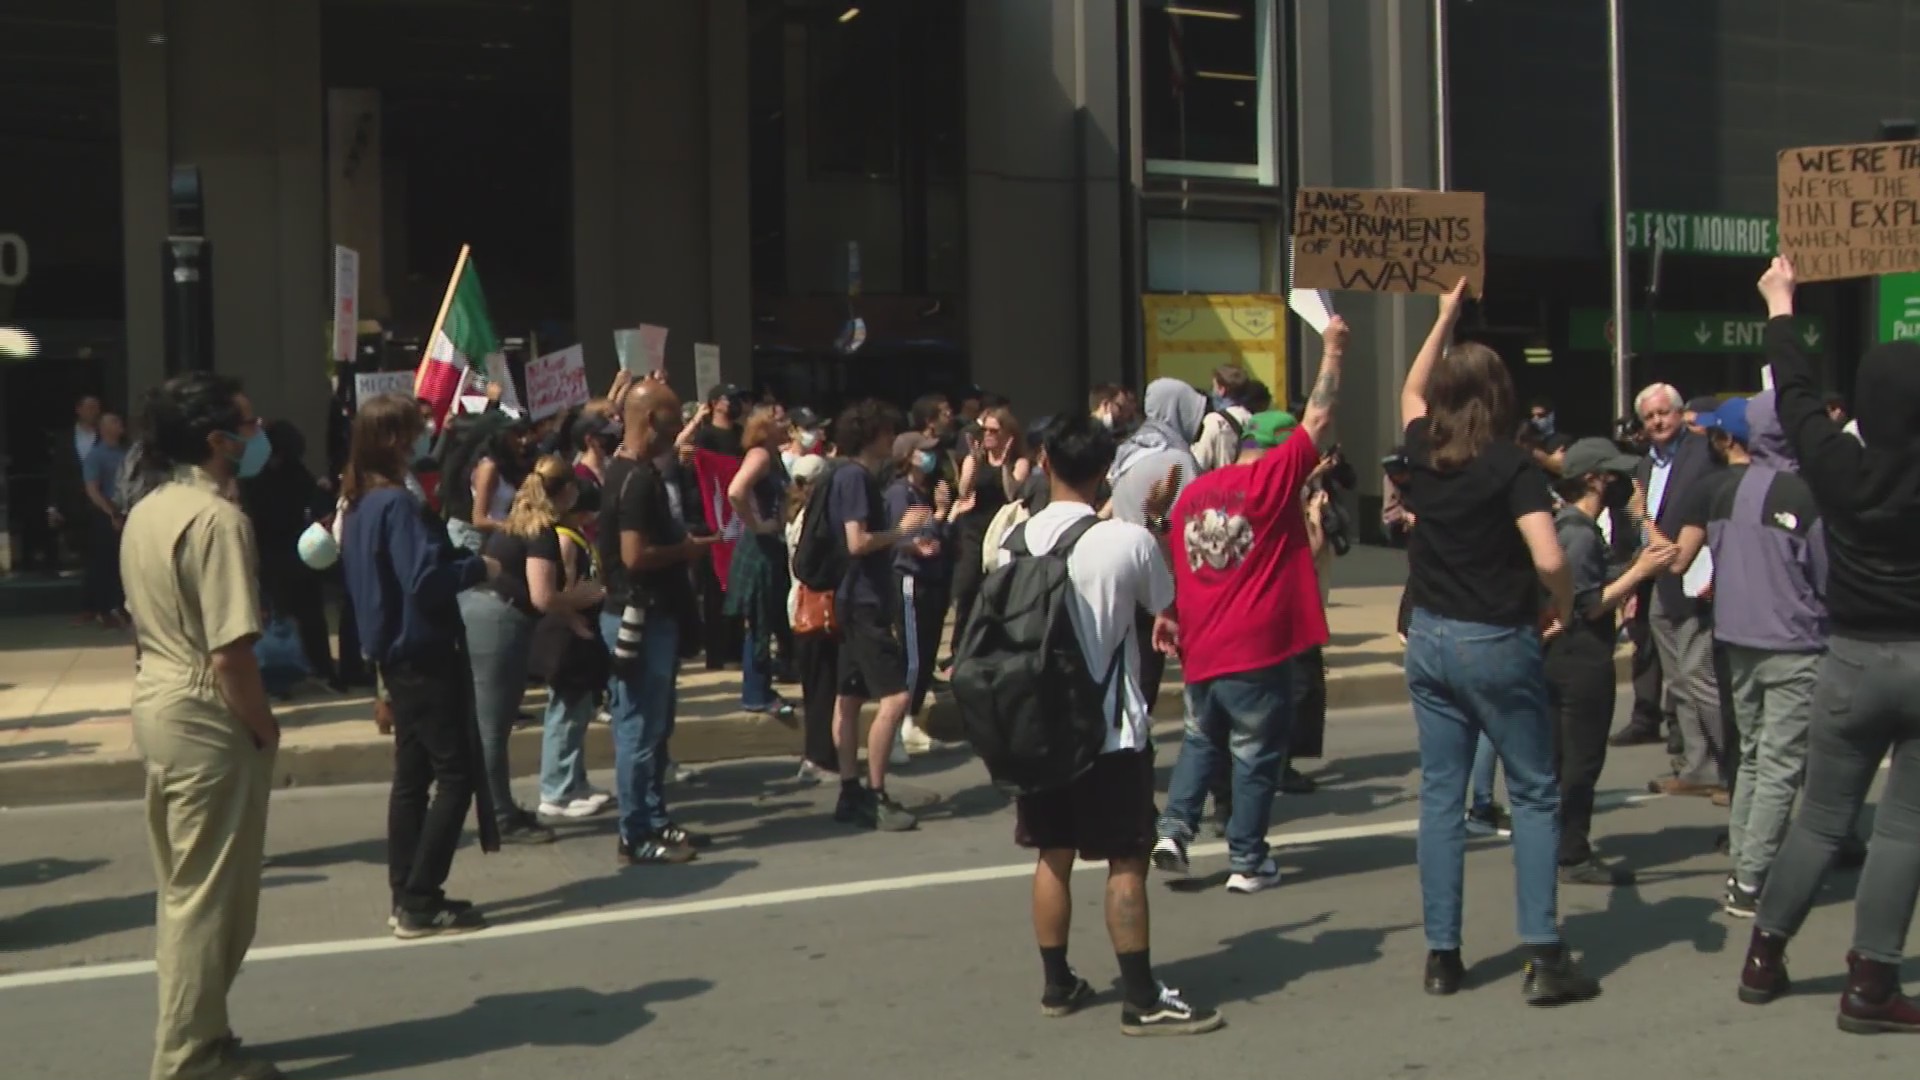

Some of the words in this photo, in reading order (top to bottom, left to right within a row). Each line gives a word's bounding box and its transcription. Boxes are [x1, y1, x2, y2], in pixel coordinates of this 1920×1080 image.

[1782, 177, 1854, 198] WE'RE
[1869, 175, 1908, 197] THE
[1303, 192, 1364, 211] LAWS
[1374, 195, 1417, 214] ARE
[1784, 201, 1837, 228] THAT
[1297, 211, 1470, 243] INSTRUMENTS
[1643, 213, 1687, 250] EAST
[1693, 216, 1770, 253] MONROE
[1785, 229, 1850, 247] WHEN
[1302, 238, 1331, 254] OF
[1340, 239, 1394, 259] RACE
[1334, 260, 1450, 292] WAR
